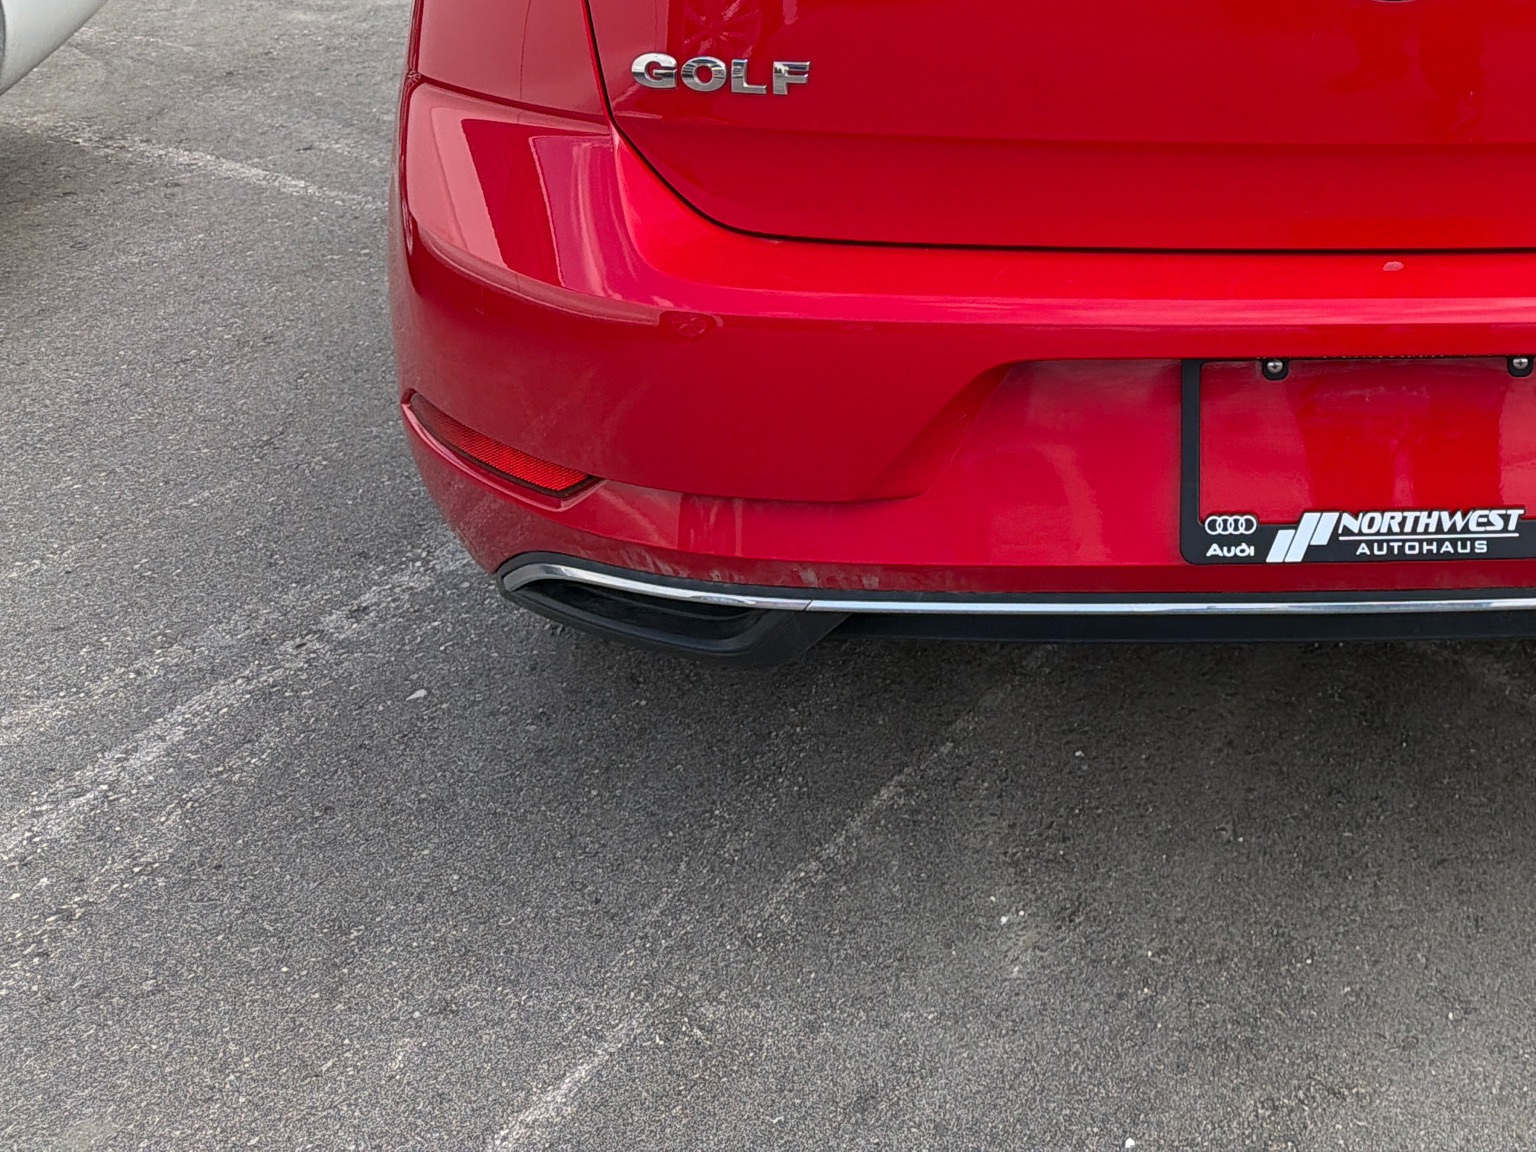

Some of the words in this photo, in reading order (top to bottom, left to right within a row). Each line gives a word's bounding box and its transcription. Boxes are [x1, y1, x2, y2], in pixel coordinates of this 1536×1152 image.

[631, 52, 811, 95] GOLF
[1338, 509, 1525, 534] NORTHWEST
[1206, 542, 1255, 557] Audi
[1356, 540, 1488, 556] AUTOHAUS
